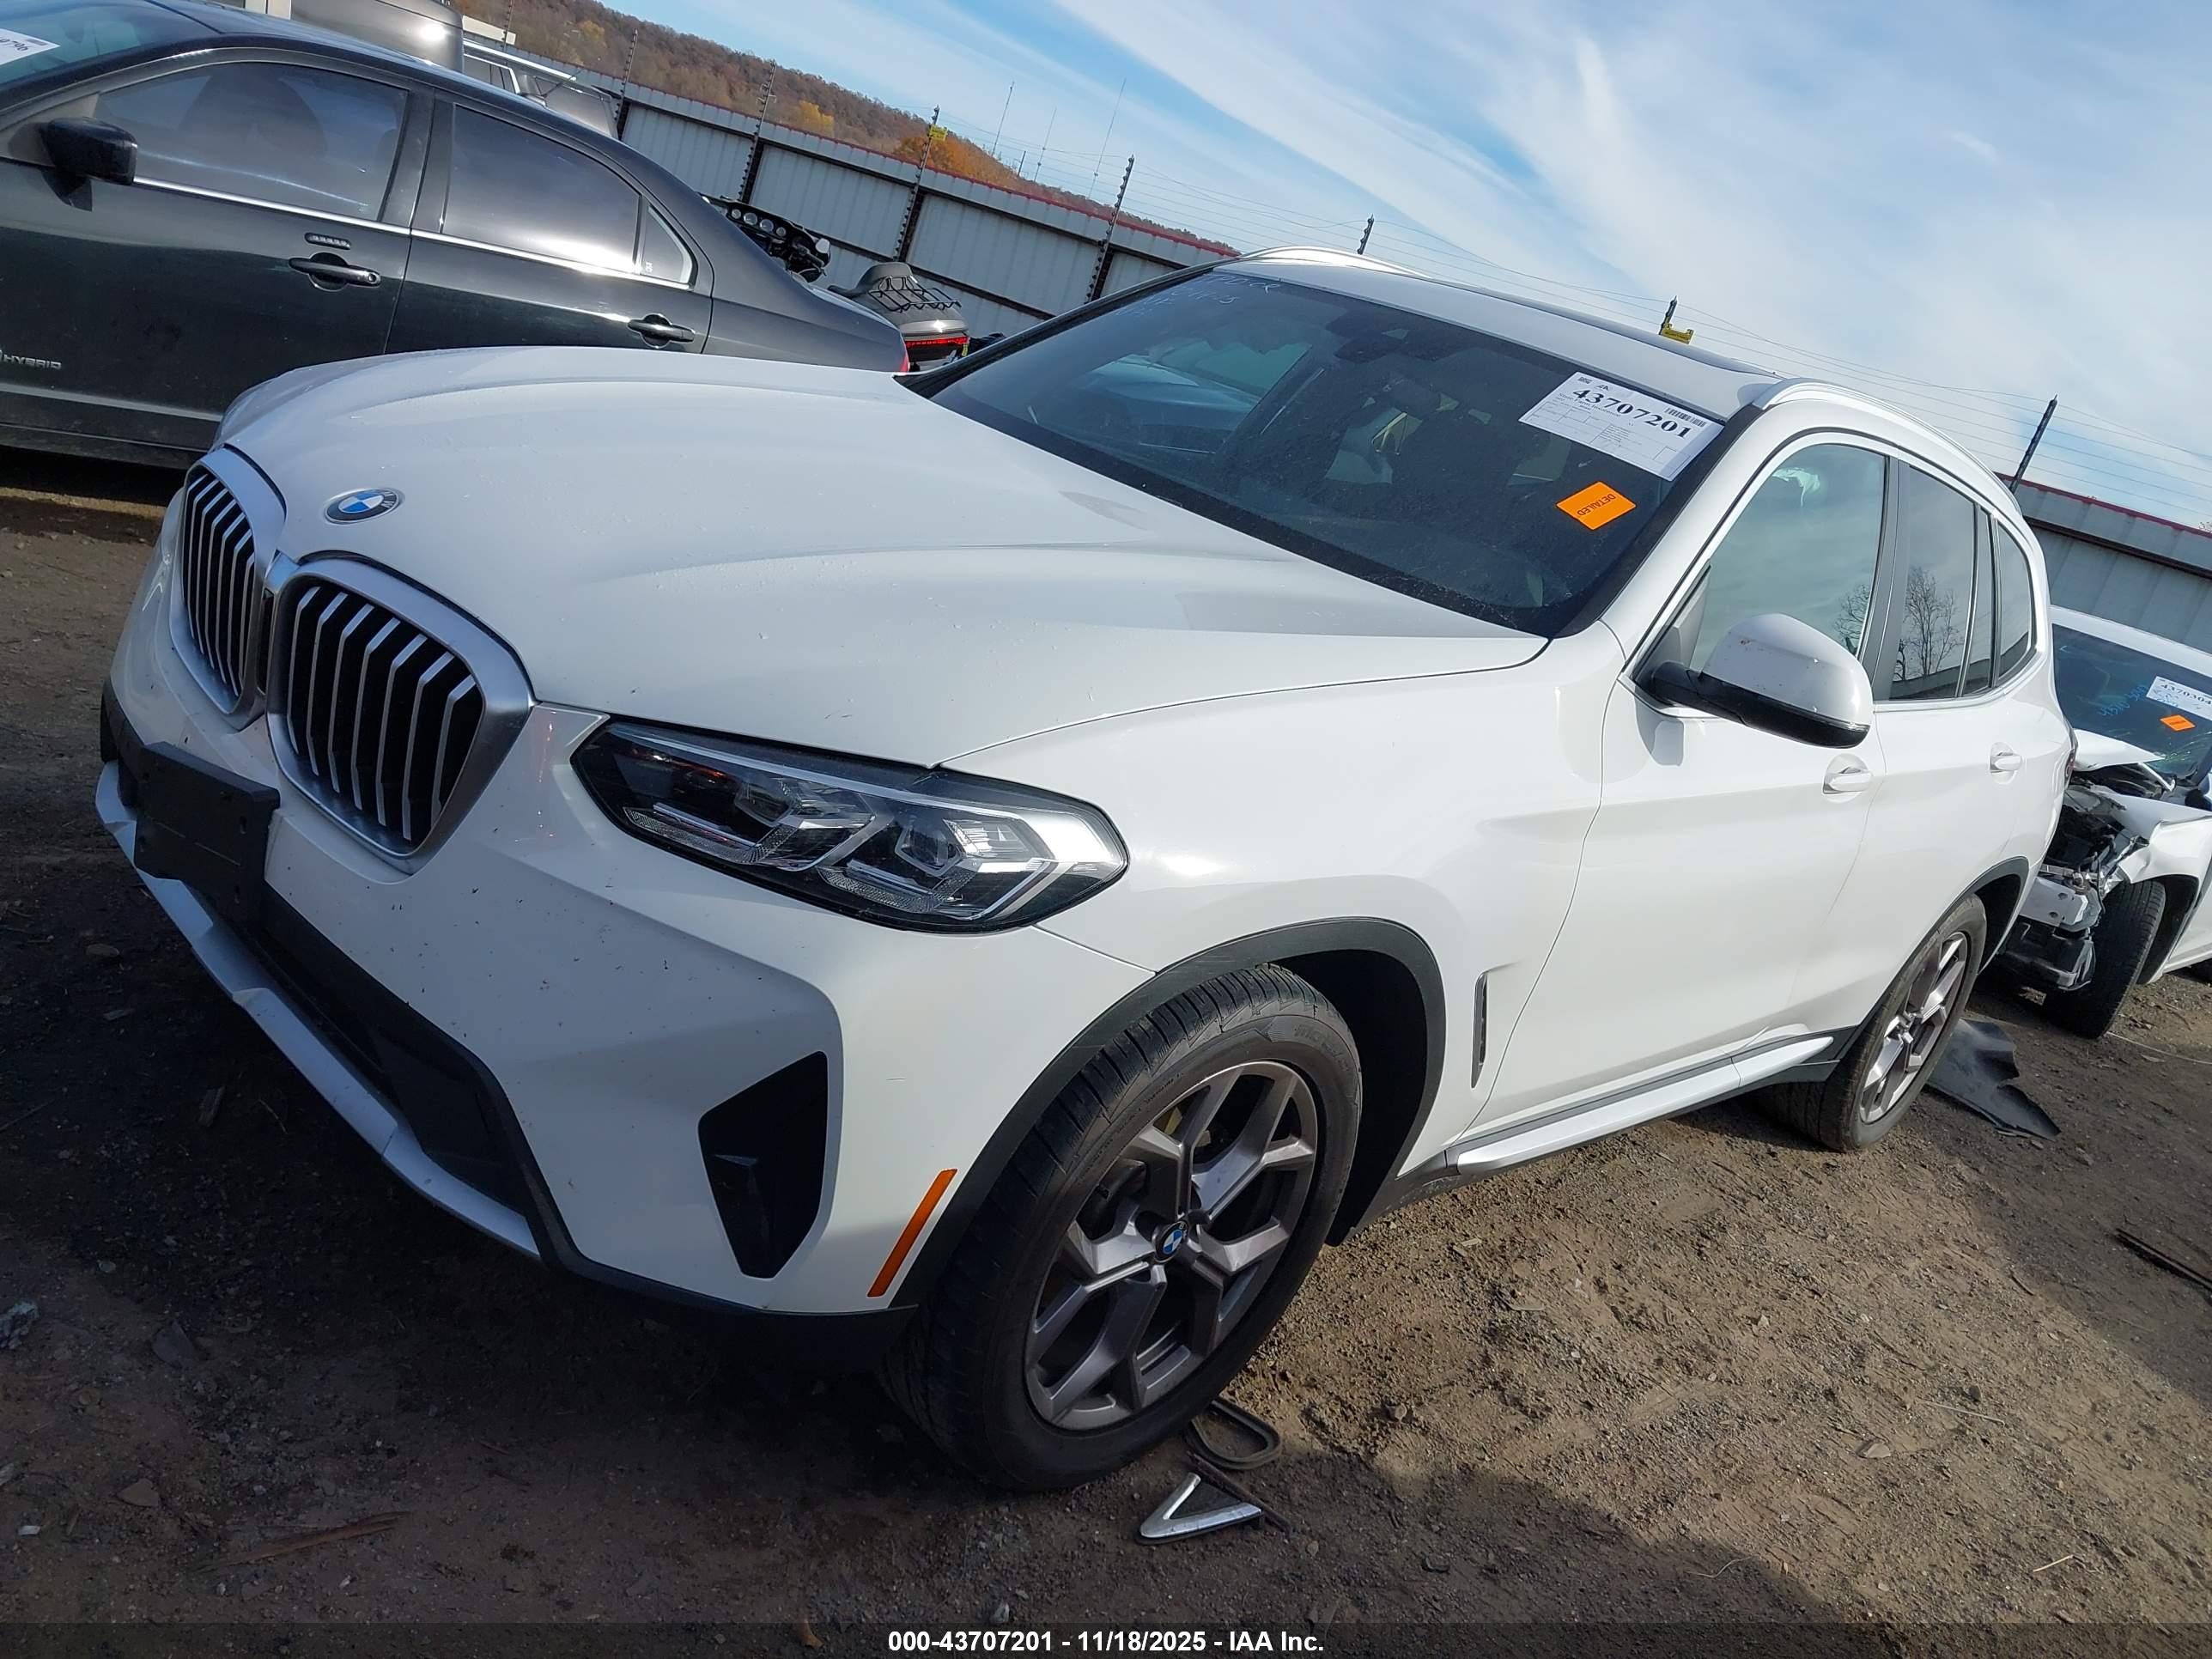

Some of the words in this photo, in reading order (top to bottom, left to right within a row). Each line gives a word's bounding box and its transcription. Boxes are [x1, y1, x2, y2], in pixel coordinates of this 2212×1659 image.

[3, 354, 62, 370] HYBRID
[1572, 388, 1692, 439] 43707201
[1577, 493, 1616, 516] DETAILED
